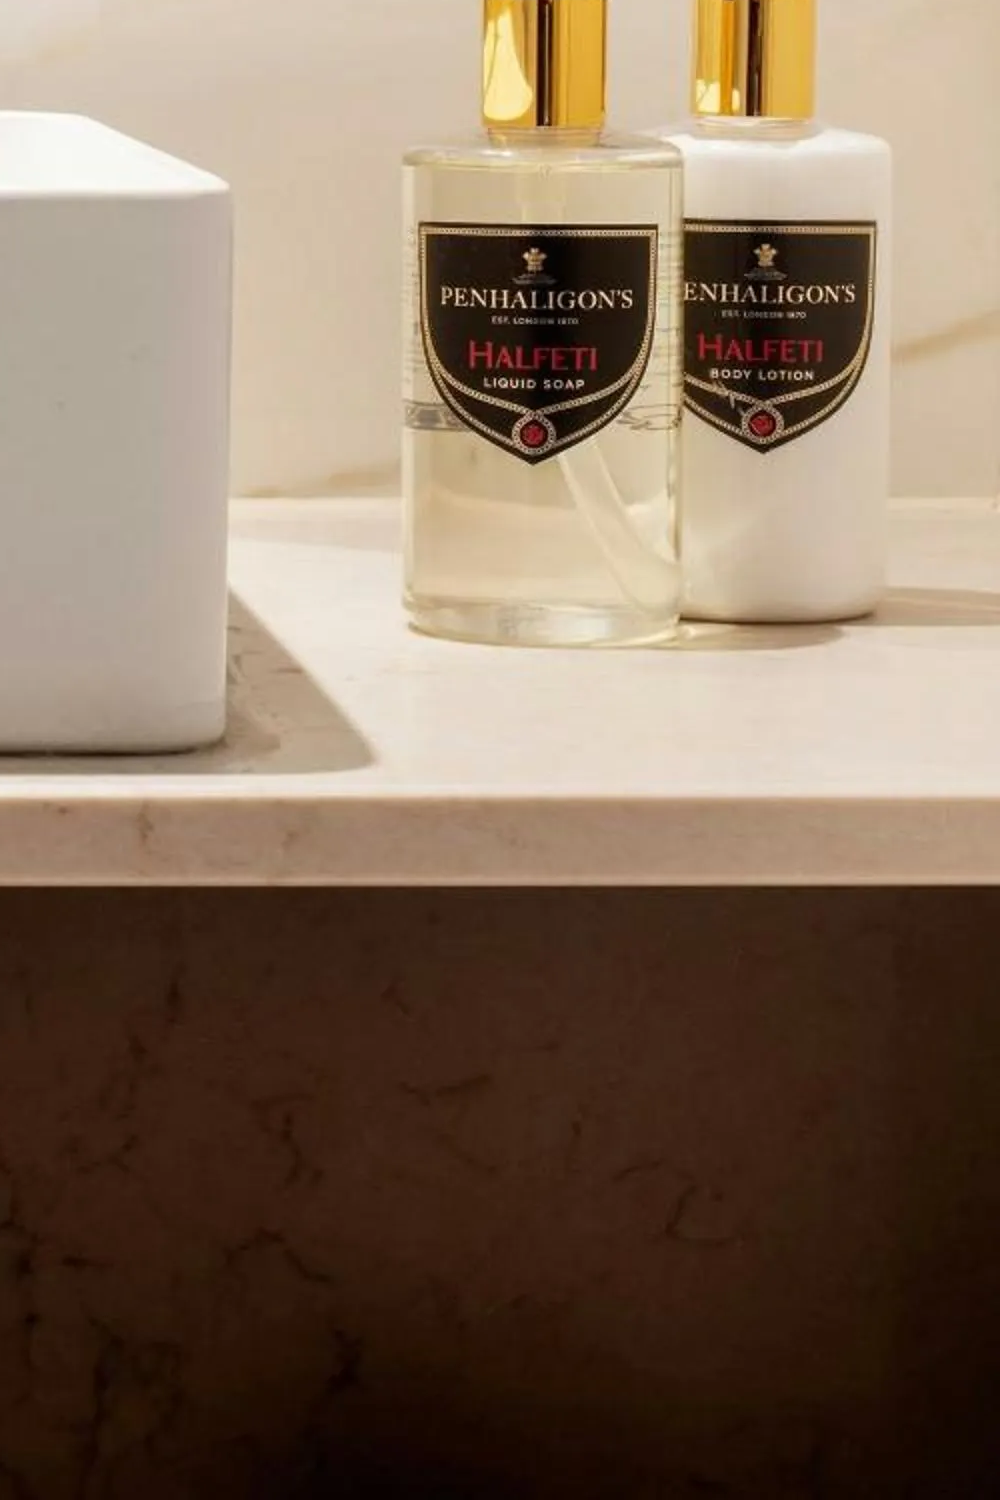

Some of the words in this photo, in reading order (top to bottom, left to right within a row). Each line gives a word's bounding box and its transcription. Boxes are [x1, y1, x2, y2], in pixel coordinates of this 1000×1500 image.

[440, 286, 633, 310] PENHALIGON'S
[683, 282, 856, 304] ENHALIGON'S
[468, 339, 598, 371] HALFETI
[697, 331, 825, 363] HALFETI
[483, 376, 537, 389] LIQUID
[543, 379, 585, 390] SOAP
[709, 368, 752, 380] BODY
[758, 369, 815, 381] LOTION
